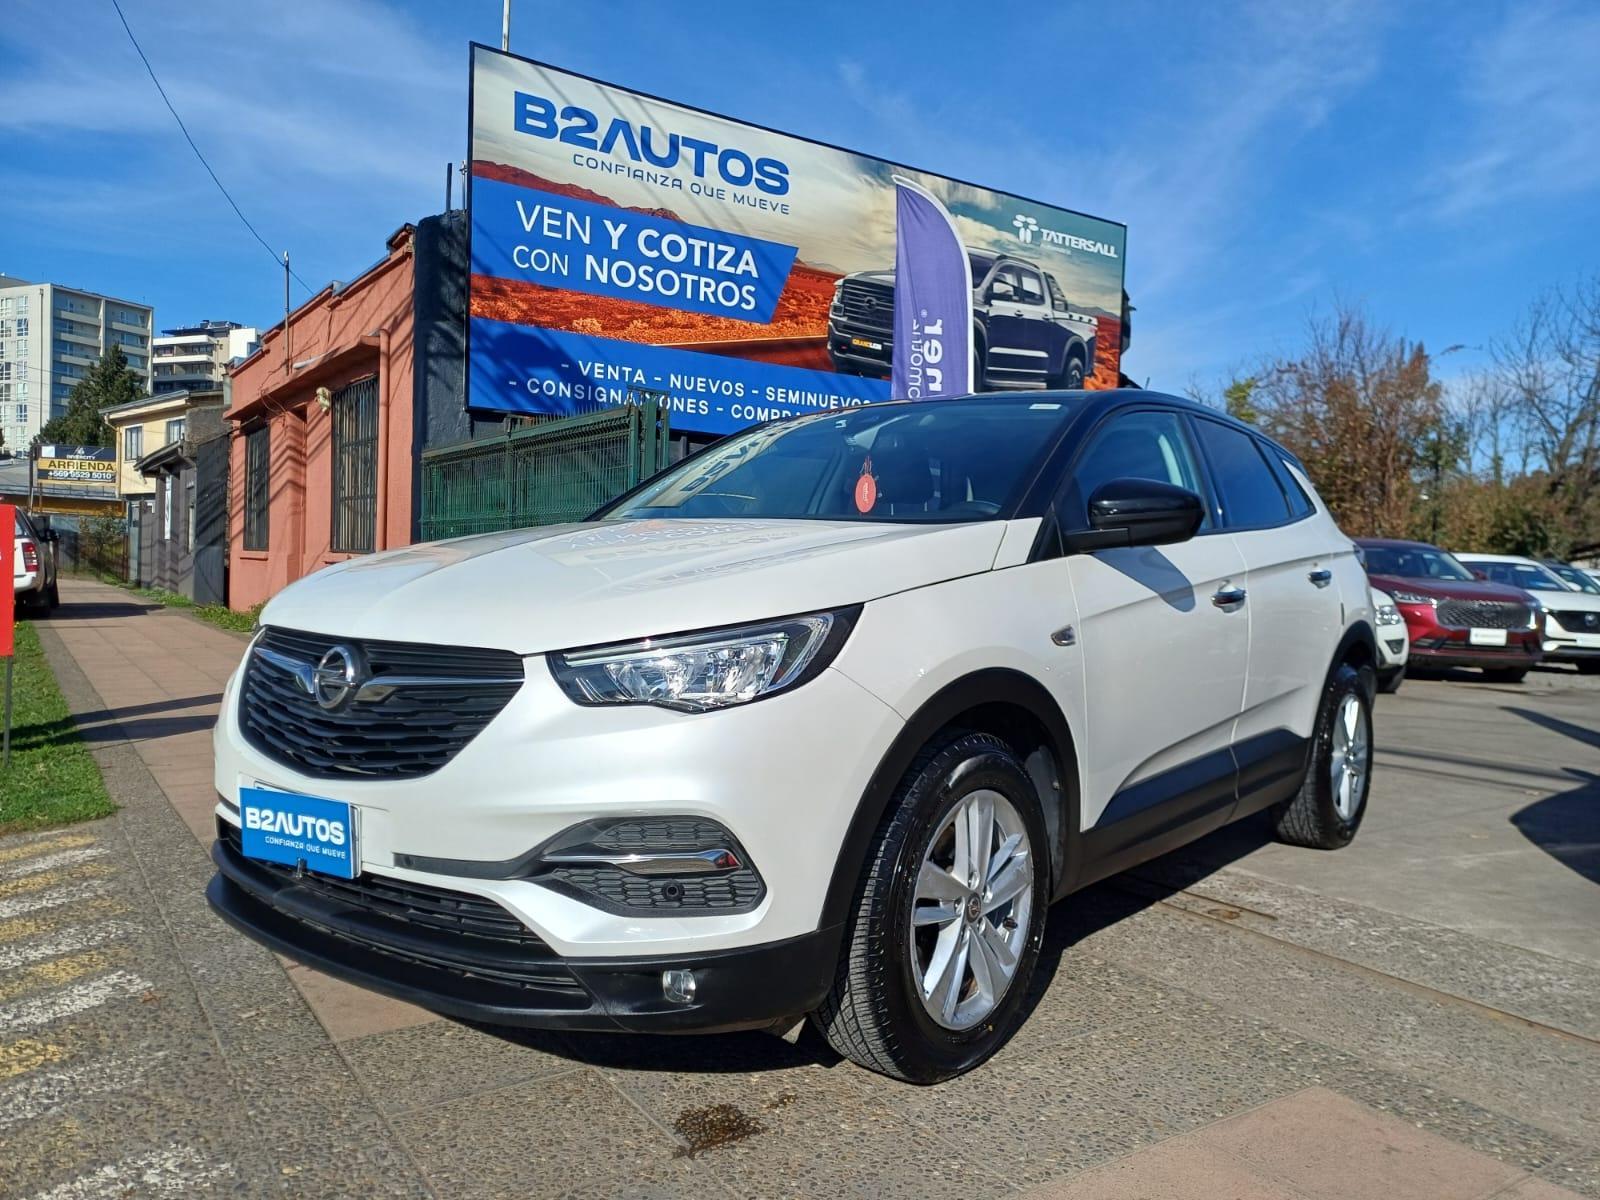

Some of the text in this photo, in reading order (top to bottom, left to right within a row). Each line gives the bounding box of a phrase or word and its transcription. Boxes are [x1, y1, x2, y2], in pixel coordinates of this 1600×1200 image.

[514, 91, 789, 195] B2AUTOS
[573, 154, 790, 215] CONFIANZA QUE MUEVE
[515, 200, 759, 278] VEN Y COTIZA
[1040, 228, 1118, 258] TATTERSALL
[513, 245, 756, 310] CON NOSOTROS
[578, 360, 646, 384] VENTA
[670, 373, 745, 397] NUEVOS
[765, 386, 871, 409] SEMINUEVO
[48, 460, 114, 471] ARRIENDA
[245, 807, 345, 845] B2AUTOS
[264, 835, 346, 859] CONFIANZA QUE MUEVE
